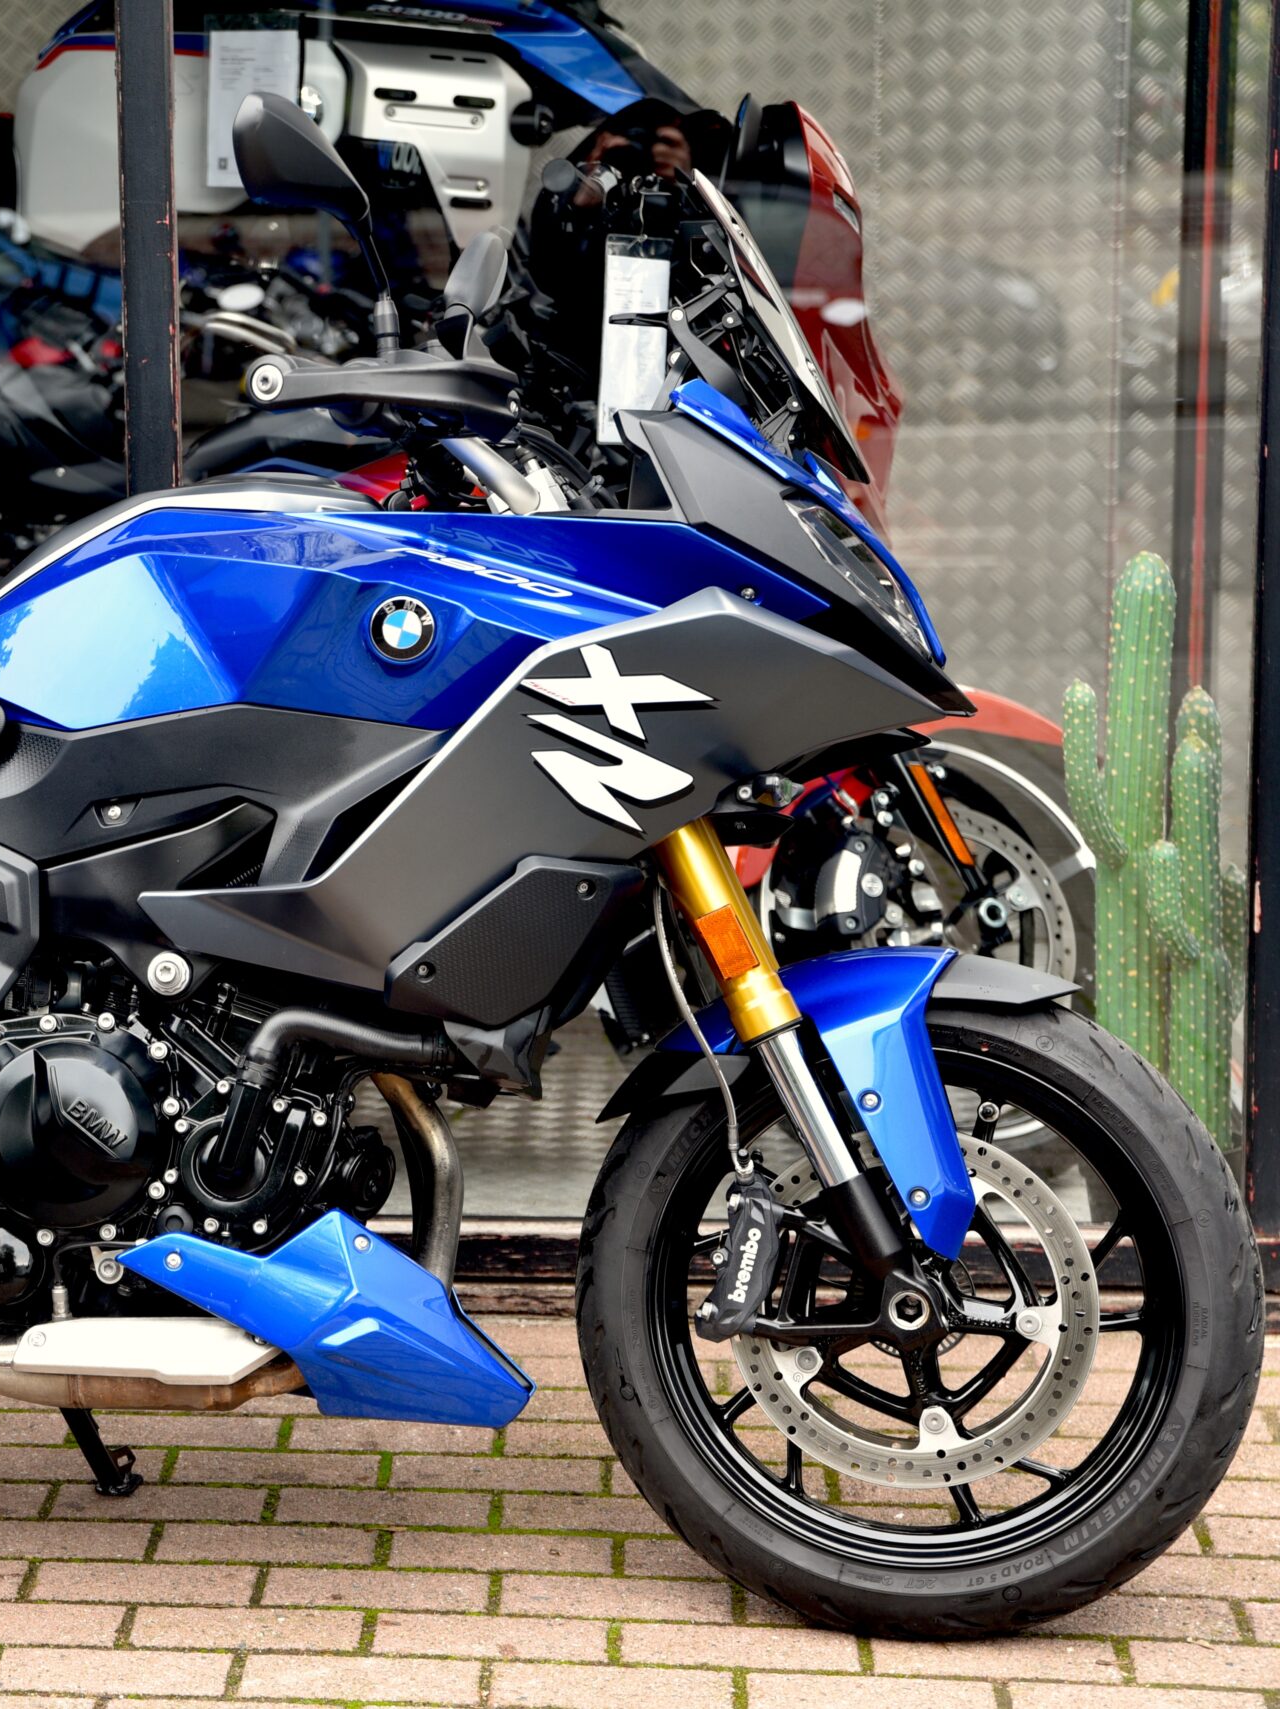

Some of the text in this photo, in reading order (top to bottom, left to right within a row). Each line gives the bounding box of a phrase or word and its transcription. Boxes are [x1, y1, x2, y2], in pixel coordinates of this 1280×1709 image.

[382, 600, 433, 626] BMW
[66, 1096, 128, 1149] BMW
[727, 1228, 762, 1304] brembo
[1062, 1448, 1166, 1552] MICHELIN
[988, 1572, 998, 1584] 5
[1001, 1552, 1045, 1578] ROAD
[966, 1577, 986, 1588] GT
